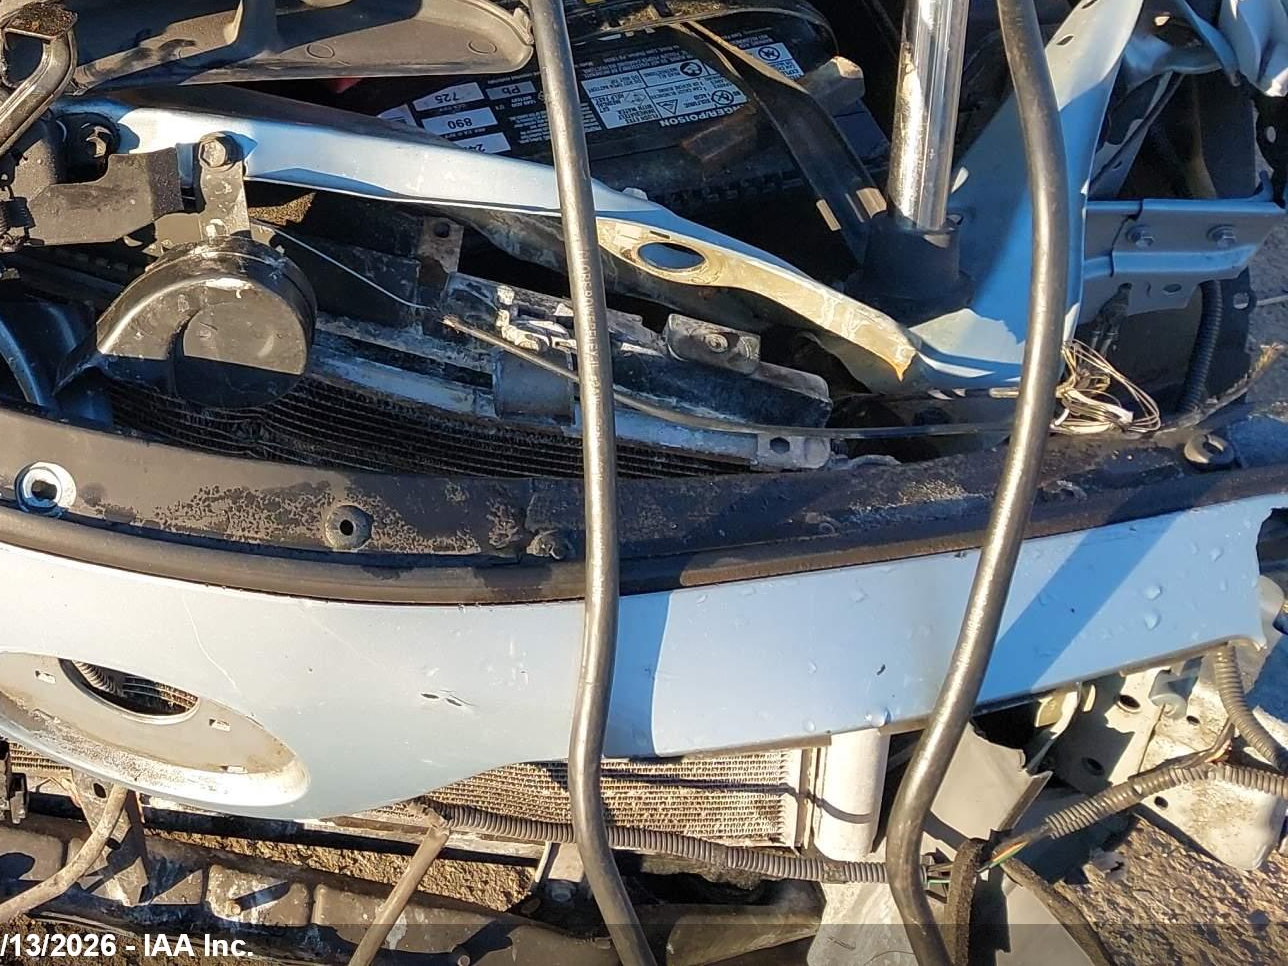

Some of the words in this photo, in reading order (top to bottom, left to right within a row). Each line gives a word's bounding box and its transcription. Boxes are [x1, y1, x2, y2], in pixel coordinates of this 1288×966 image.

[502, 86, 521, 95] Pb
[434, 91, 461, 104] 725
[447, 118, 473, 130] 890
